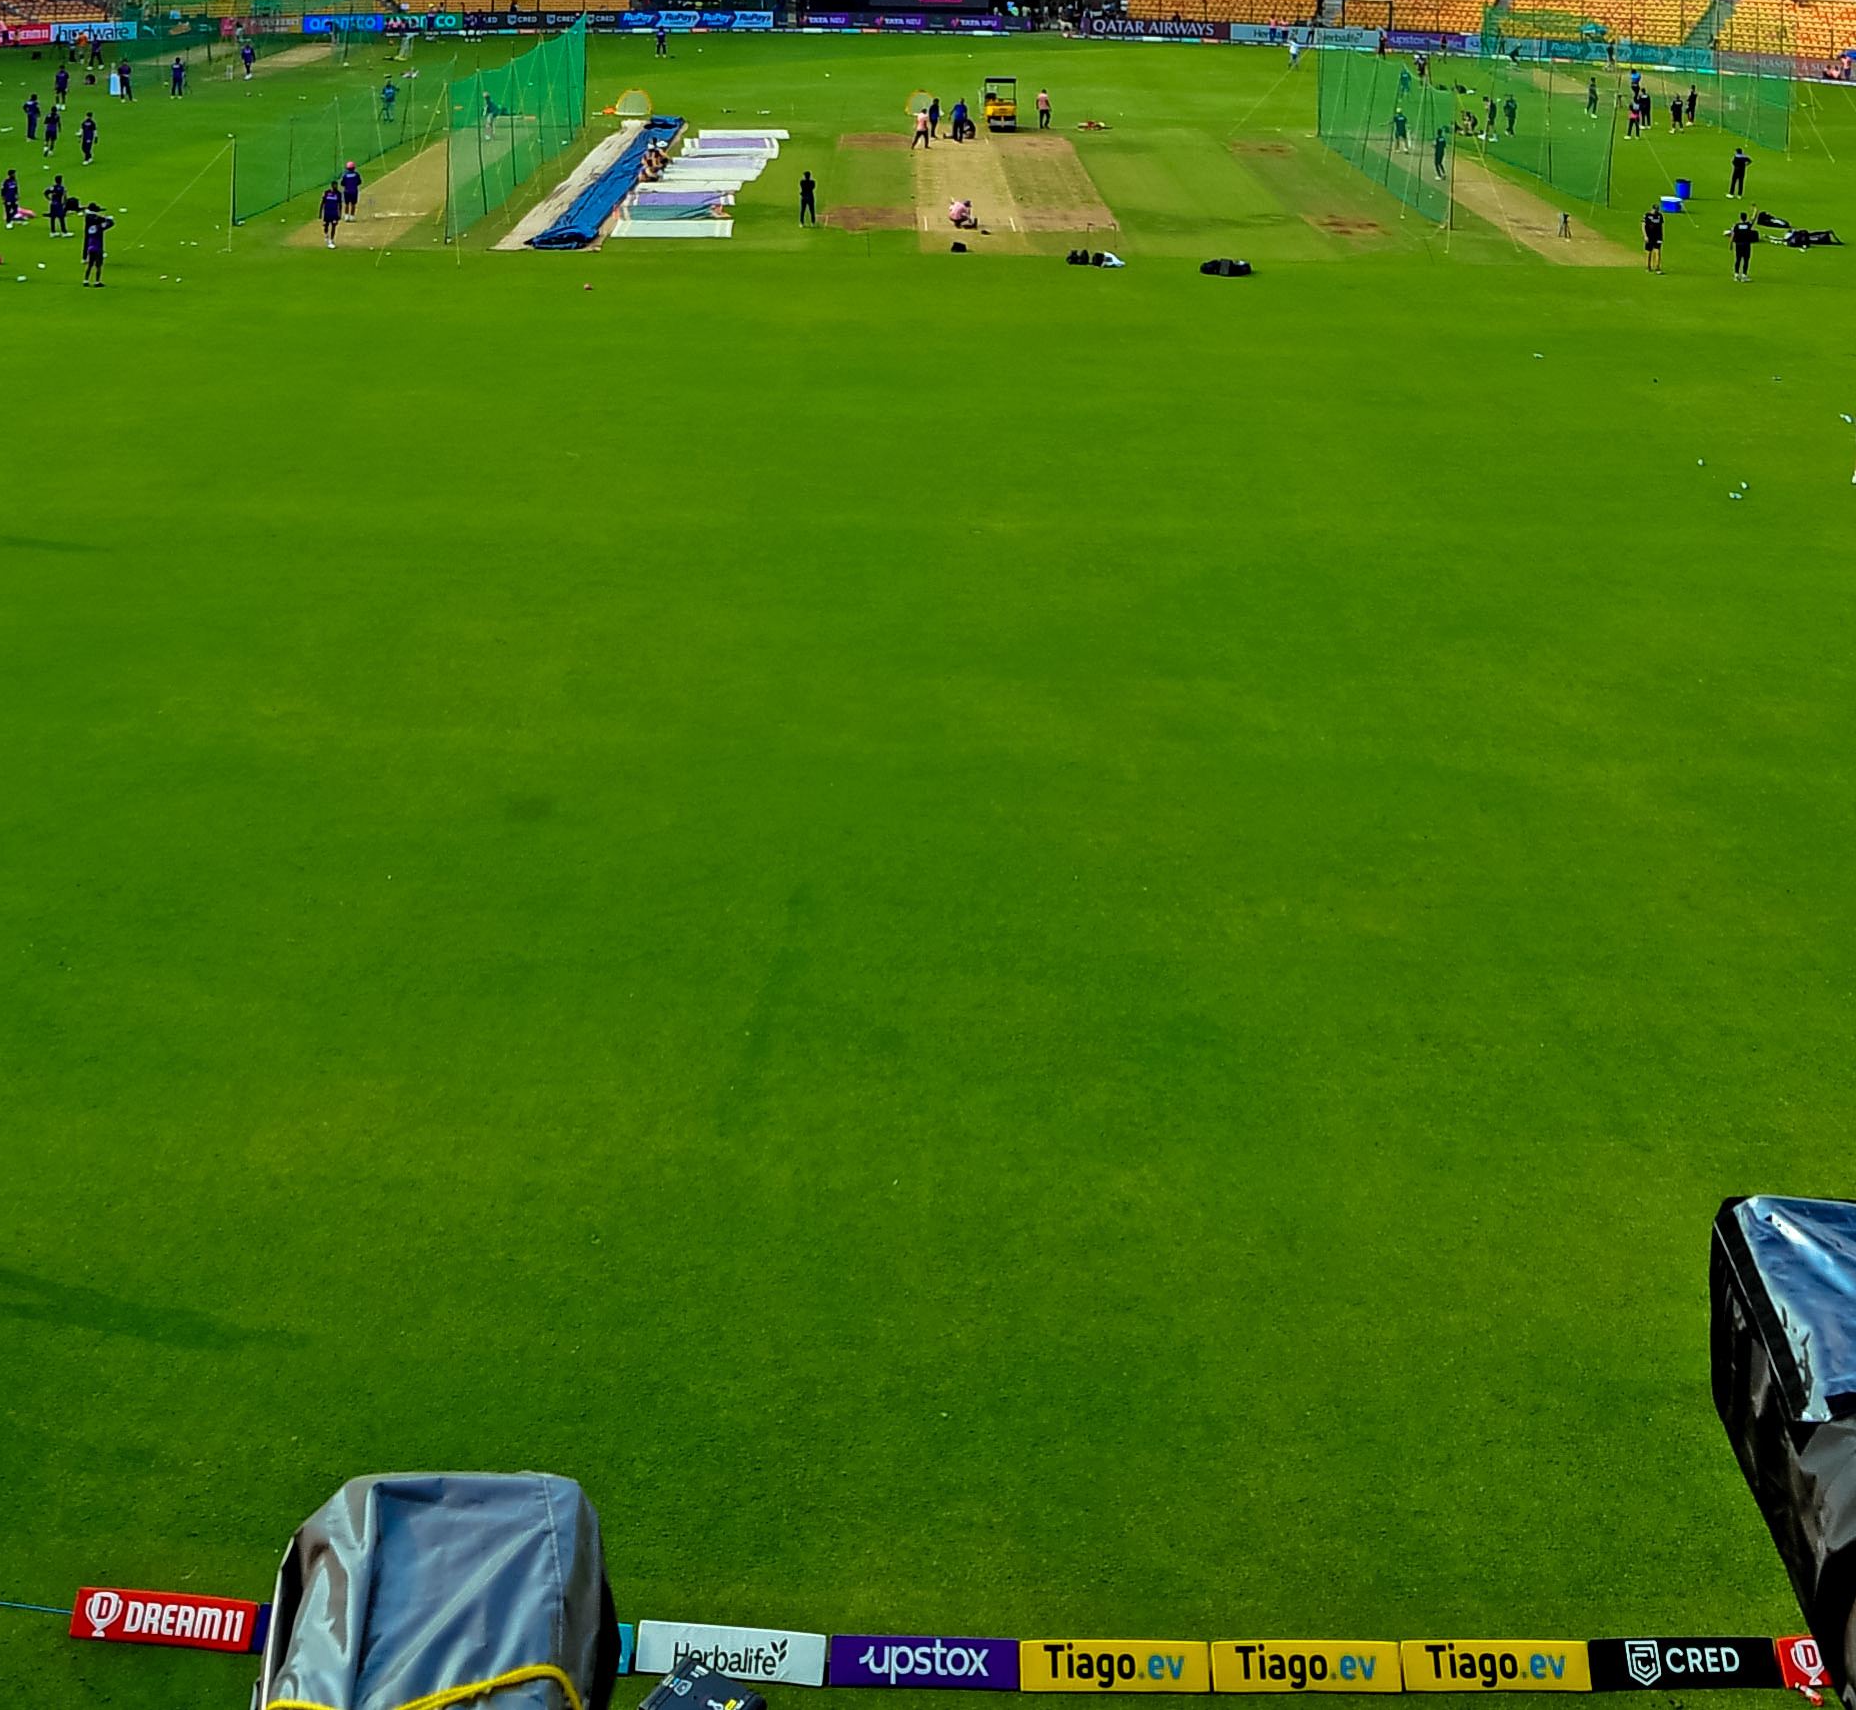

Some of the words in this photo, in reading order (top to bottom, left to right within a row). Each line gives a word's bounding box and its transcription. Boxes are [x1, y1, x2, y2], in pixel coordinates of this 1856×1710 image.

[1093, 19, 1144, 34] QATAR
[1148, 21, 1215, 36] AIRWAYS
[122, 1600, 245, 1643] DREAM11
[674, 1640, 777, 1676] Herbalife
[859, 1639, 989, 1685] upstox
[1044, 1644, 1185, 1688] Tiago.ev
[1235, 1645, 1377, 1690] Tiago.ev
[1425, 1644, 1566, 1689] Tiago.ev
[1666, 1646, 1740, 1675] CRED
